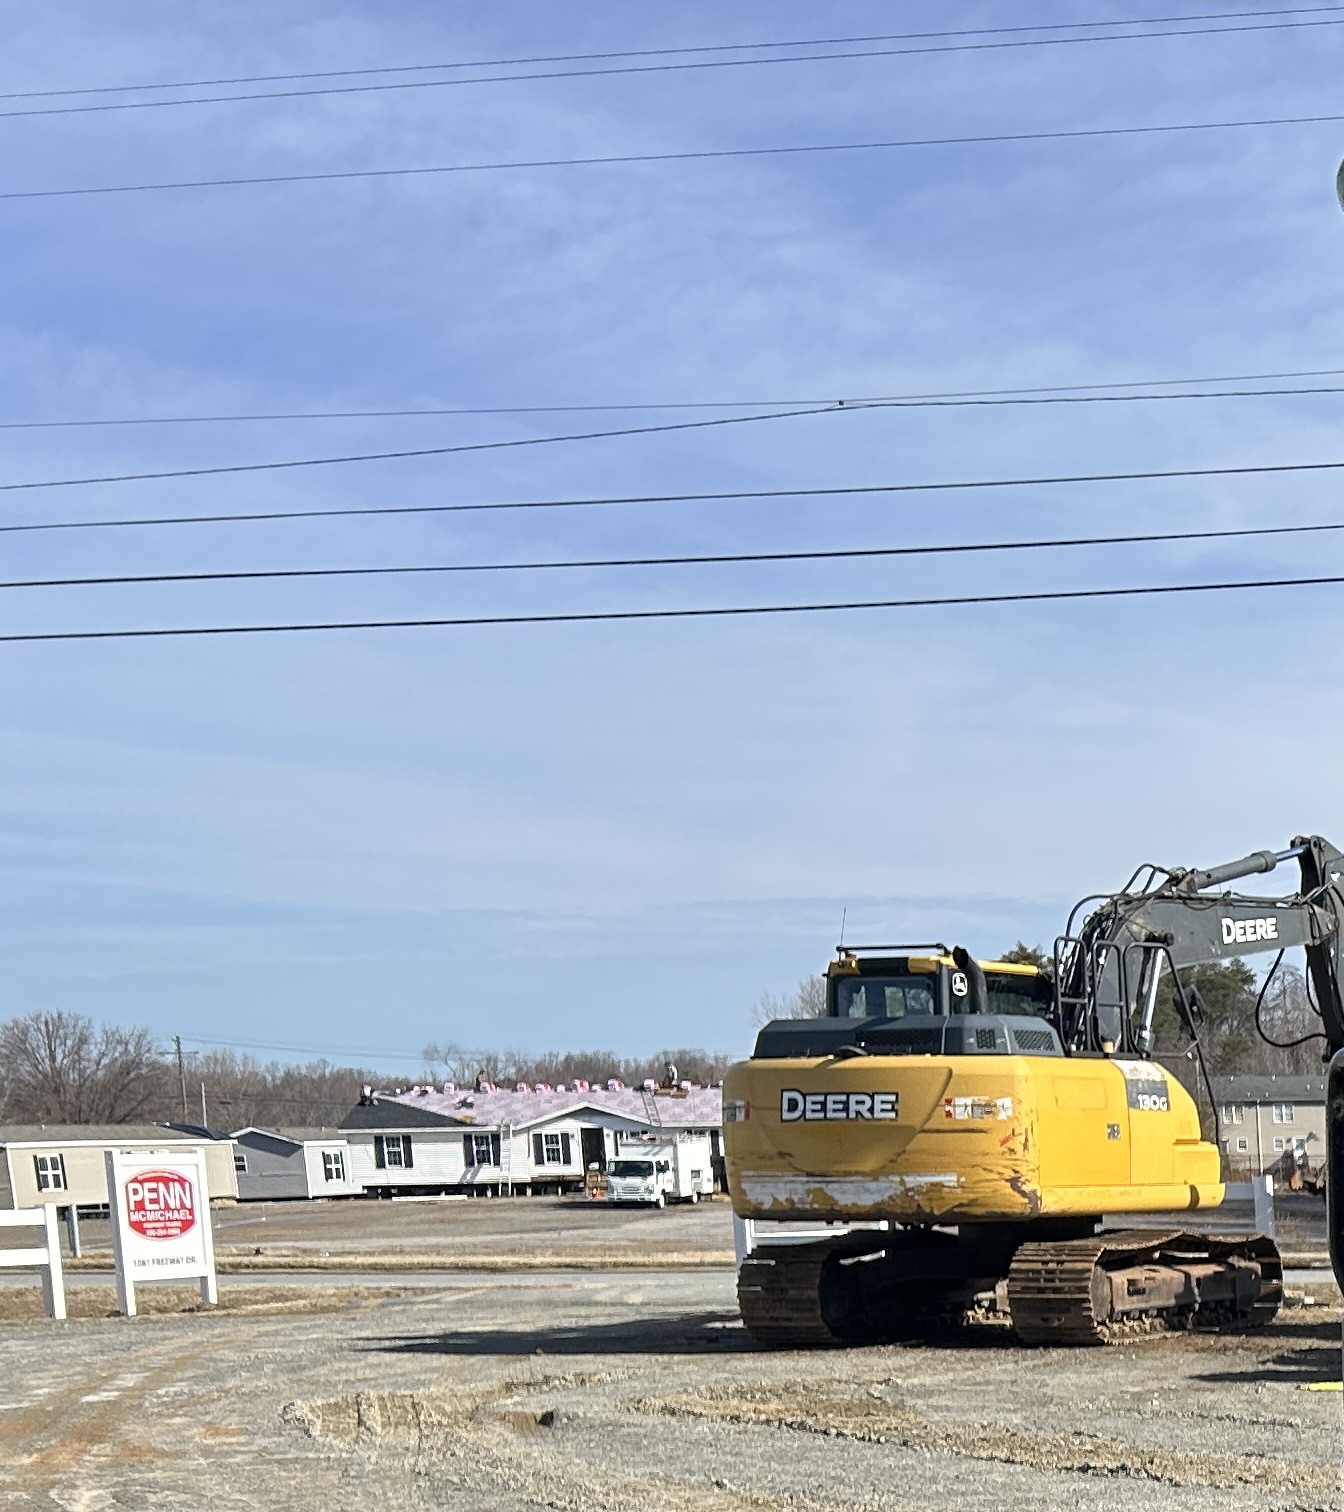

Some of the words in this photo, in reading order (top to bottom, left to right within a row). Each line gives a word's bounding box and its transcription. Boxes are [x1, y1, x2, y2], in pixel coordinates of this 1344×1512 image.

[1221, 917, 1279, 944] DEERE
[781, 1090, 897, 1120] DEERE
[127, 1181, 192, 1210] PENN
[129, 1209, 193, 1222] MCMICHAEL
